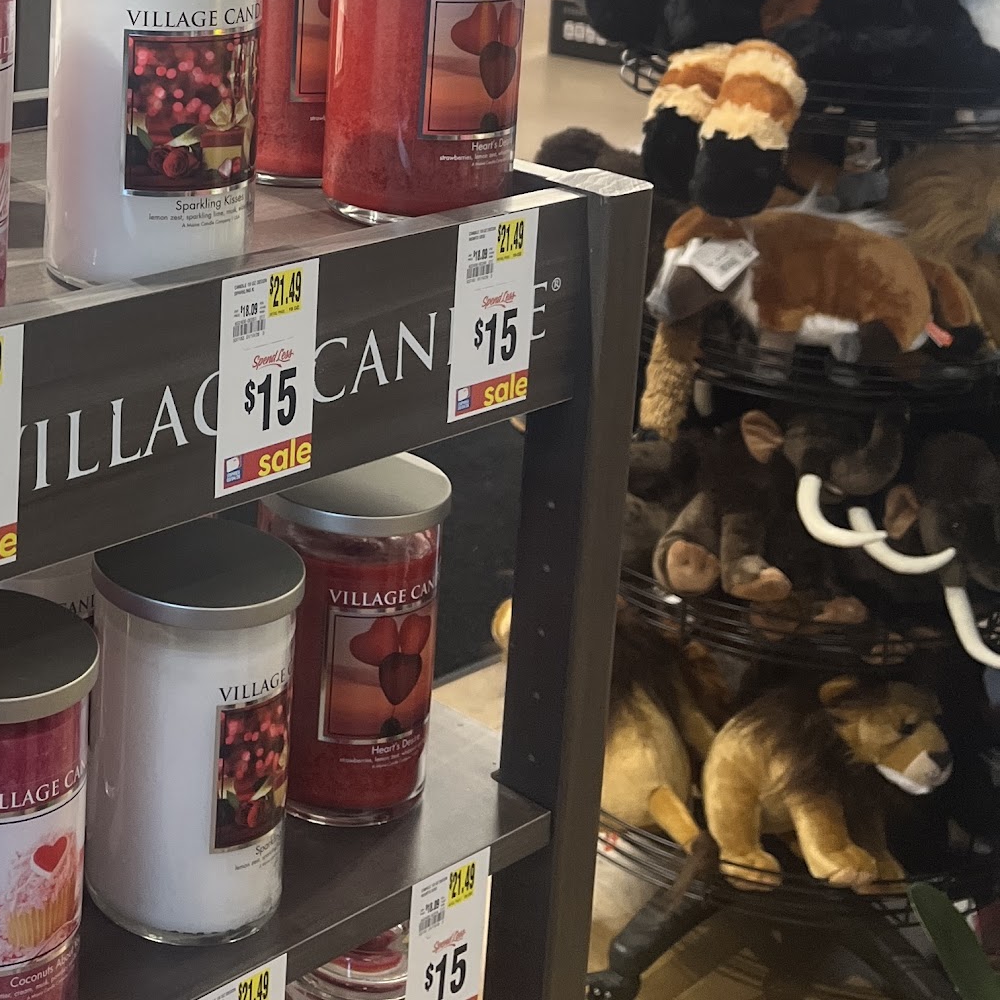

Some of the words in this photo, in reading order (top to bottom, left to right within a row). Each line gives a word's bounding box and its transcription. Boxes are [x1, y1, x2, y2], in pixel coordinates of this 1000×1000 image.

[126, 9, 218, 28] VILLAGE
[471, 140, 498, 151] Heart's
[149, 213, 168, 221] lemon
[170, 213, 184, 222] zest,
[186, 211, 212, 222] sparkling
[175, 197, 221, 213] Sparkling
[497, 220, 524, 254] $21.49
[269, 271, 302, 308] $21.49
[481, 292, 503, 309] Spend
[474, 307, 518, 365] $15
[252, 352, 278, 370] Spend
[276, 348, 294, 362] Less
[244, 367, 297, 431] $15
[483, 372, 528, 407] sale
[258, 438, 312, 477] sale
[329, 588, 407, 606] VILLAGE
[219, 669, 286, 702] VILLAGE
[371, 742, 400, 755] Heart's
[449, 863, 475, 899] $21.49
[10, 965, 54, 988] Coconuts
[424, 943, 468, 1000] $15
